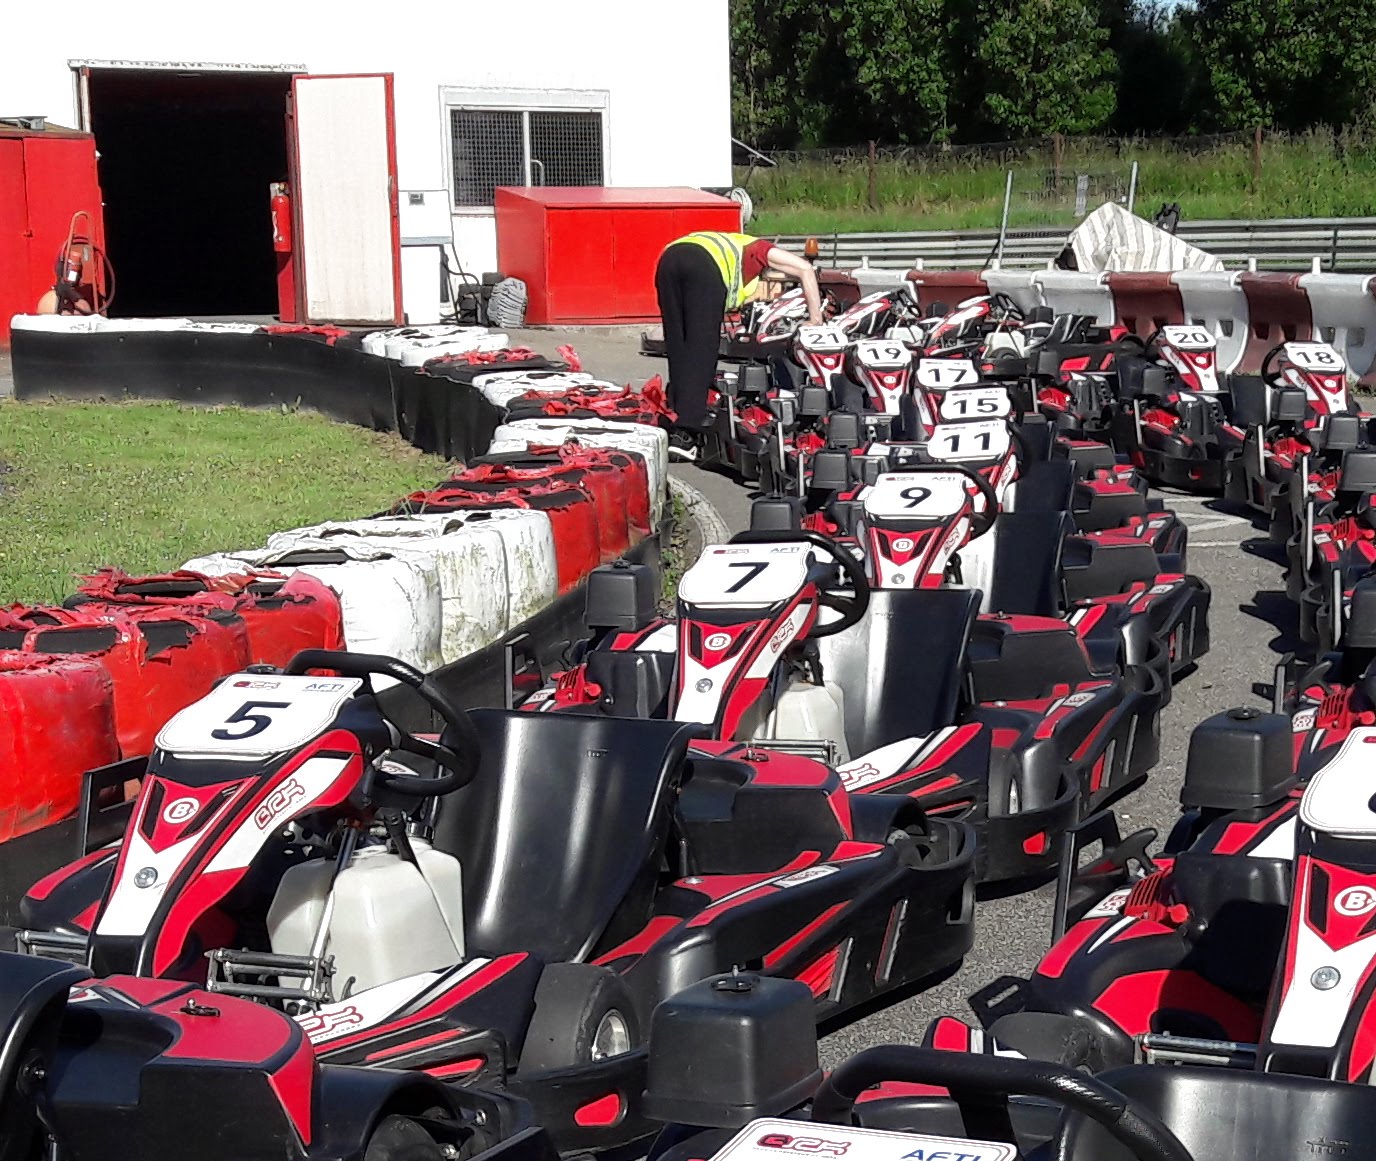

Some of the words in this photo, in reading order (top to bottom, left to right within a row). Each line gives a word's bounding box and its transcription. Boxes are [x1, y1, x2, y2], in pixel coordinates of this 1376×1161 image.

[808, 333, 840, 345] 21
[1173, 332, 1209, 344] 20
[867, 347, 902, 360] 19
[1296, 351, 1335, 364] 18
[927, 368, 968, 383] 17
[953, 397, 999, 415] 15
[943, 432, 991, 452] 11
[899, 486, 932, 509] 9
[723, 561, 770, 594] 7
[210, 700, 293, 741] 5
